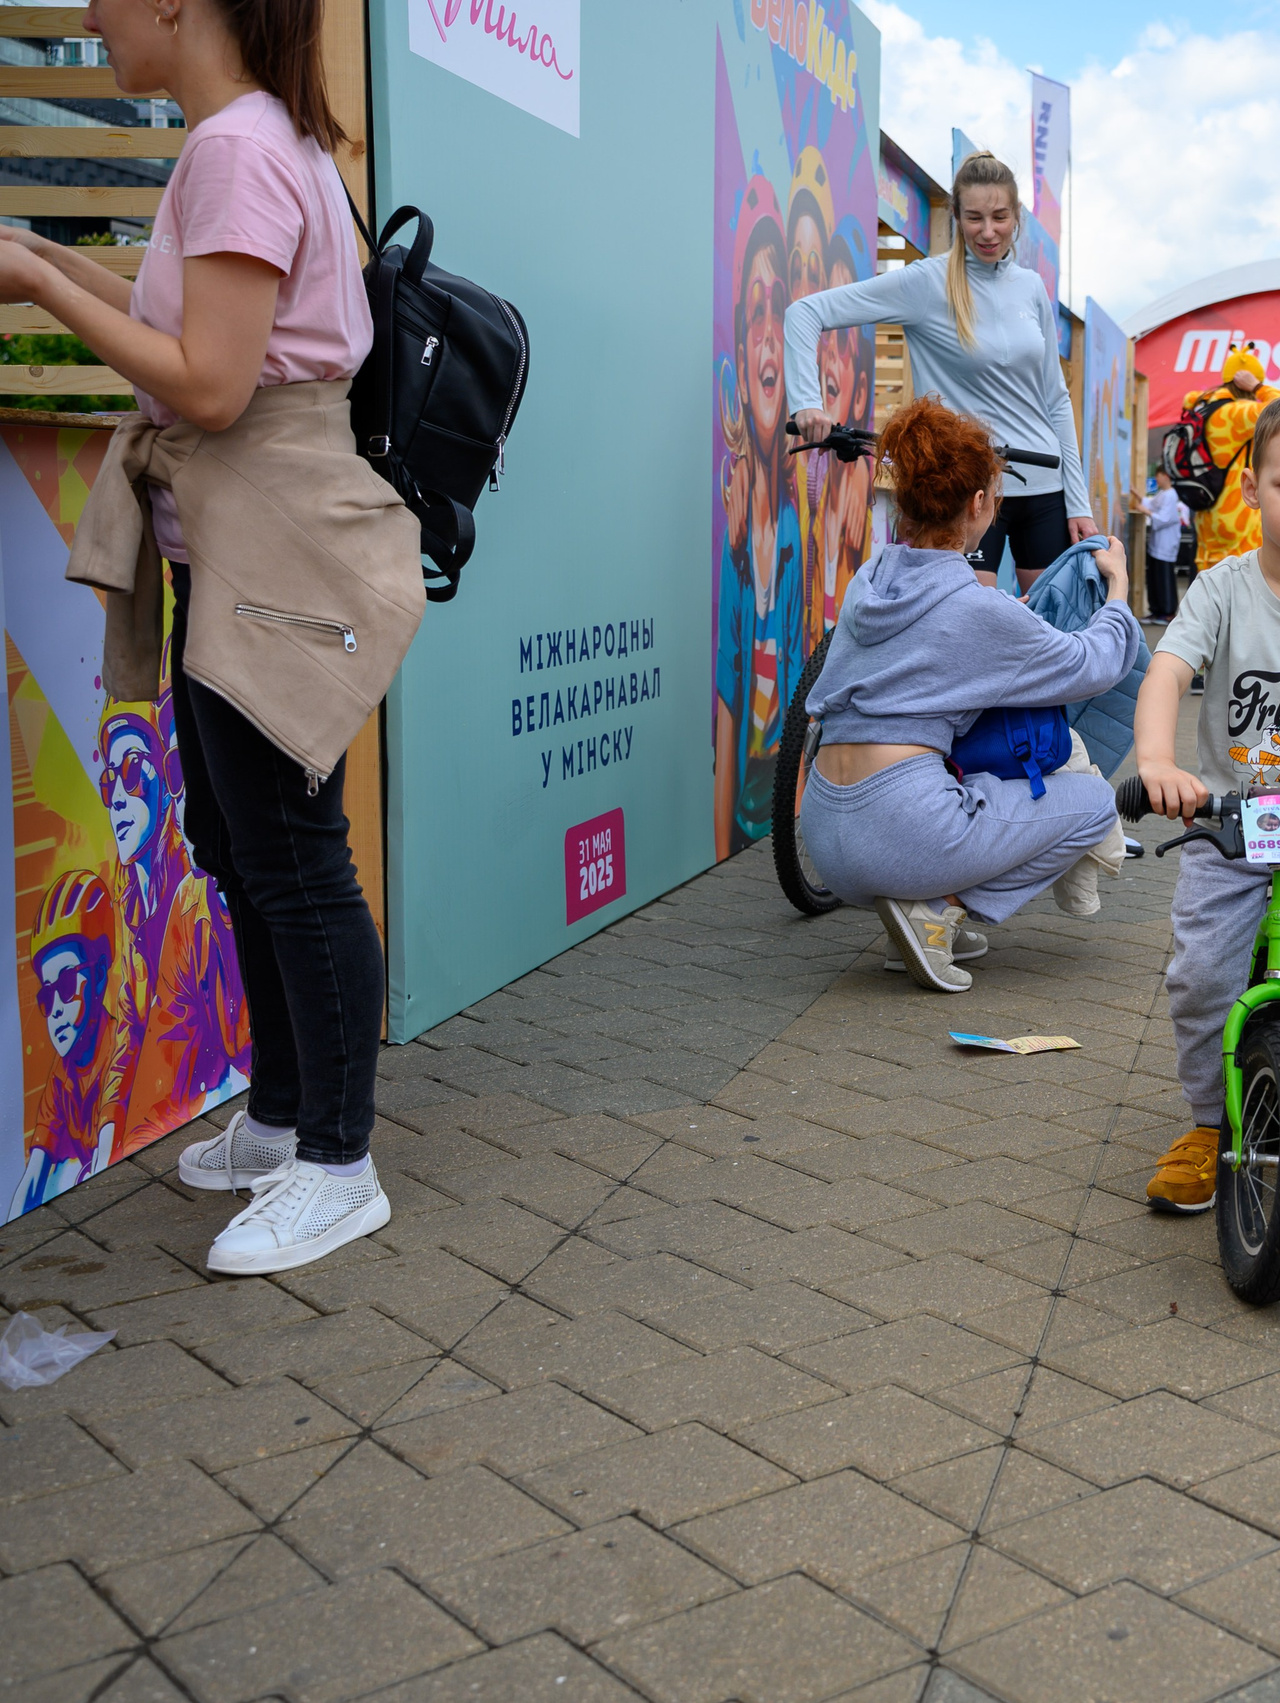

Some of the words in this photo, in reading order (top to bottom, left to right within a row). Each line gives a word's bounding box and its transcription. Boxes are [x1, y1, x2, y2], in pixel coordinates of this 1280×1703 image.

[519, 617, 655, 673] МІЖНАРОДНЫ
[511, 667, 661, 737] ВЕЛАКАРНАВАЛ
[541, 750, 552, 788] У
[562, 726, 634, 780] МІНСКУ
[579, 838, 590, 864] 31
[592, 828, 612, 858] МАЯ
[579, 854, 614, 901] 2025
